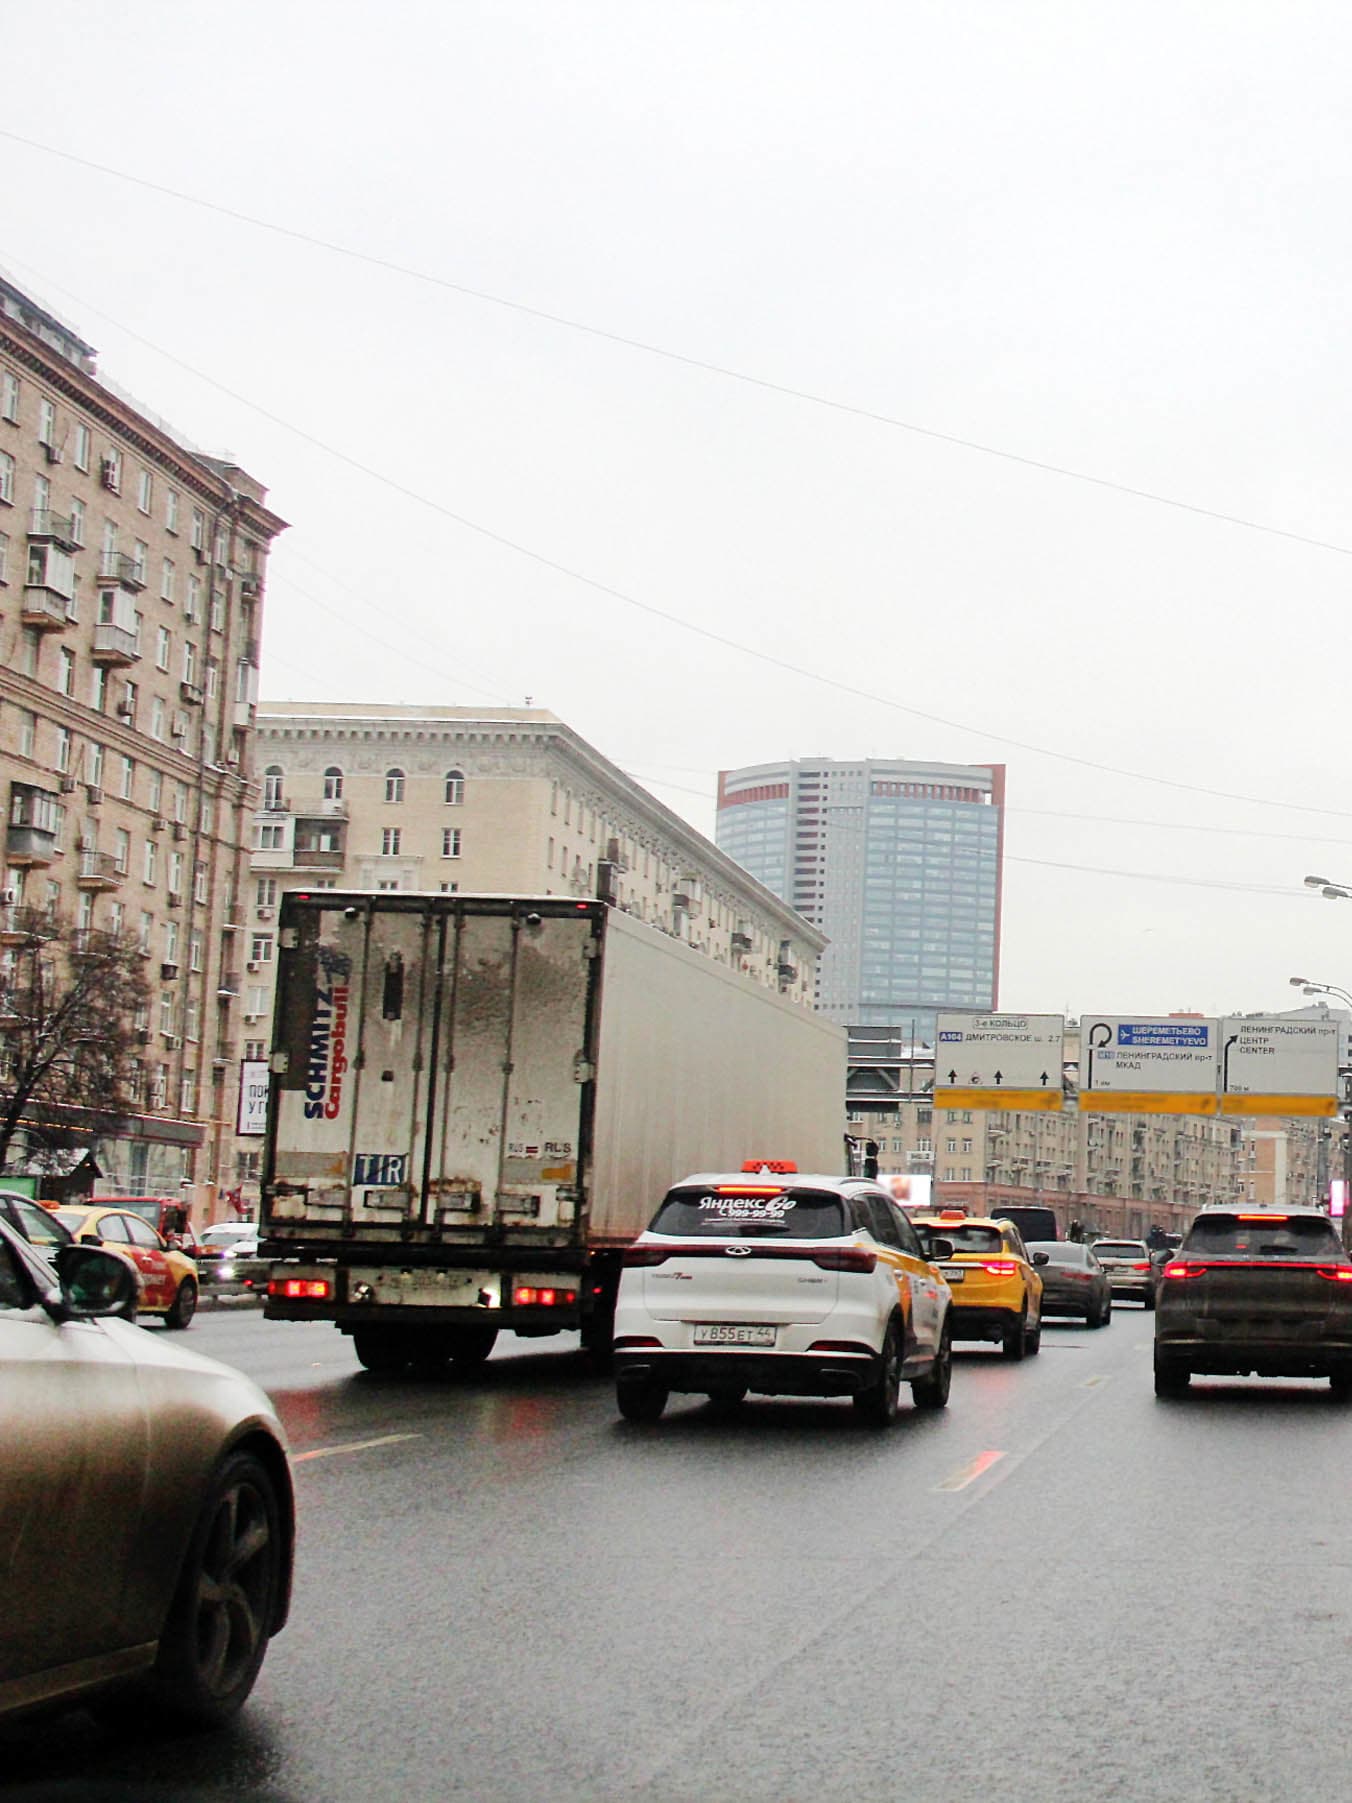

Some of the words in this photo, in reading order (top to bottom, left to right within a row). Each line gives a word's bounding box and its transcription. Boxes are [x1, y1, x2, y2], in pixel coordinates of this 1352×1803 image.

[990, 1019, 1028, 1029] КОЛЬЦО
[1132, 1026, 1201, 1036] ШЕРЕМЕТЬЕВО
[1240, 1025, 1317, 1035] ЛЕНИНГРАДСКИЙ
[965, 1033, 1033, 1042] ДМИТРОВСКОЕ
[1240, 1037, 1270, 1045] ЦЕНТР
[304, 986, 333, 1119] SCHMITZ
[325, 987, 350, 1119] Cargobull
[1240, 1046, 1275, 1055] CENTER
[1116, 1051, 1194, 1061] ЛЕНИНГРАДСКИЙ
[1116, 1061, 1141, 1070] МКАД
[359, 1156, 403, 1183] TIR
[698, 1196, 766, 1210] Яндекс
[765, 1196, 798, 1211] Go
